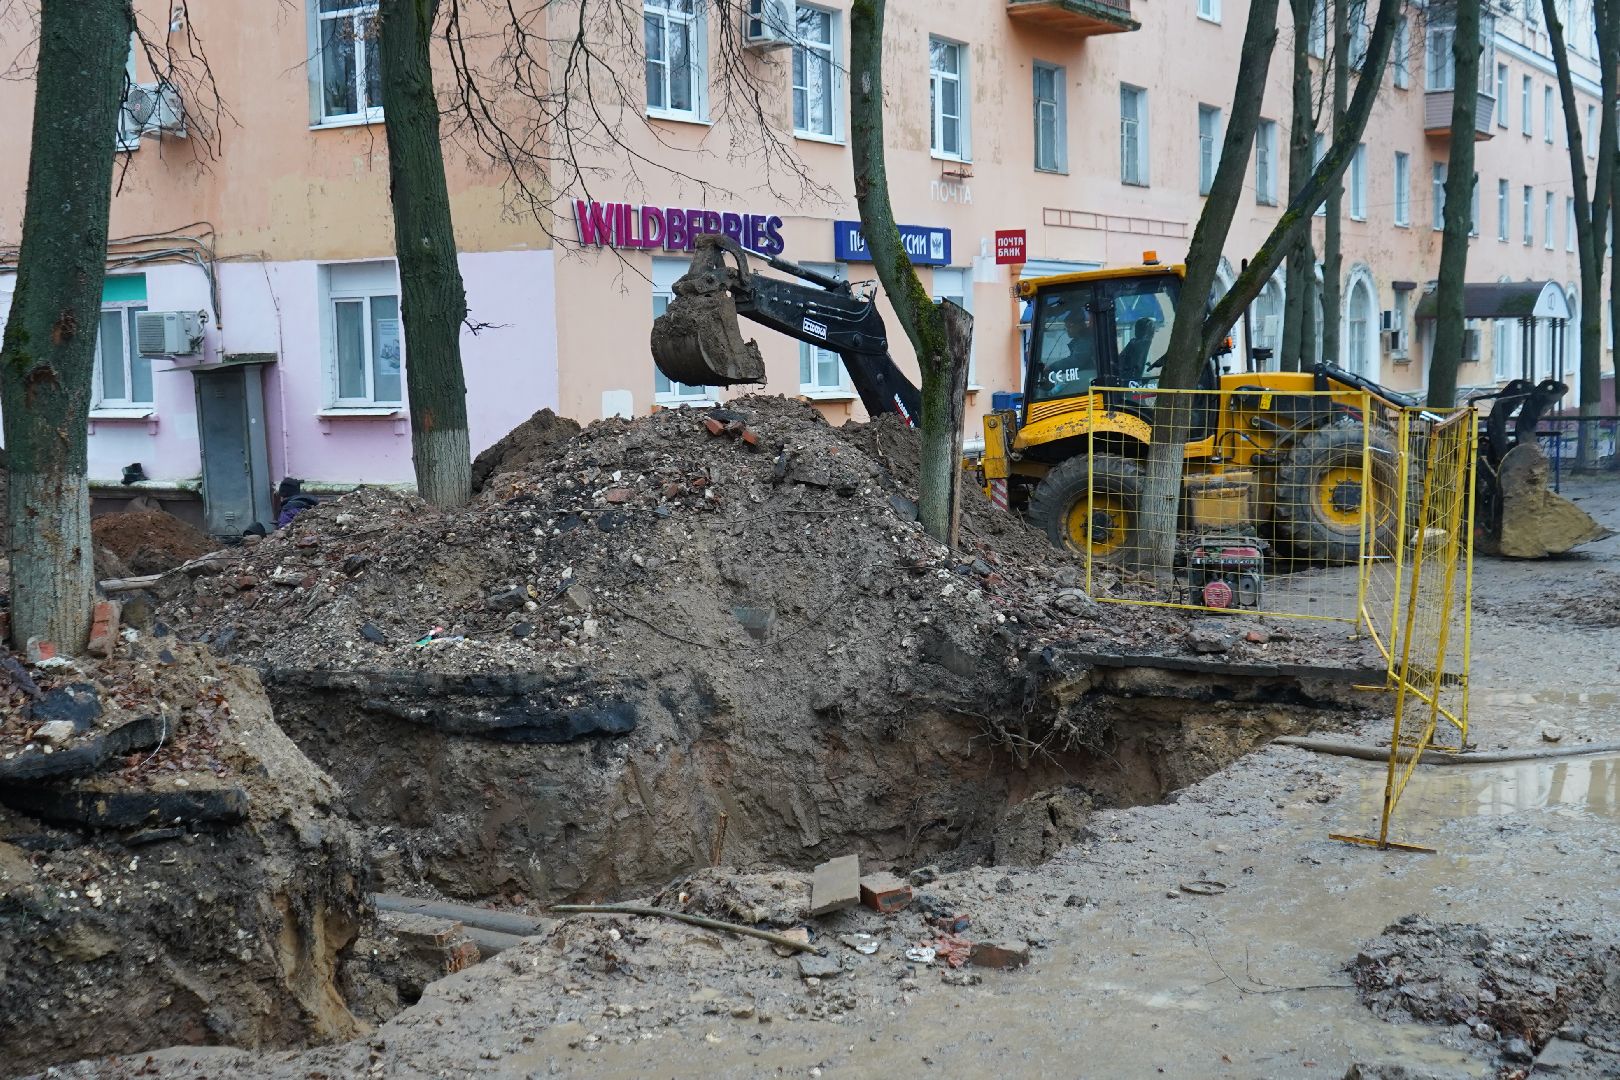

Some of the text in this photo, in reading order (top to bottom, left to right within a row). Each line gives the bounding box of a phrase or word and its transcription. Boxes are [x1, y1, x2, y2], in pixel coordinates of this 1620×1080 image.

[930, 180, 973, 205] ПОЧТА
[573, 199, 785, 256] WILDBERRIES
[998, 237, 1024, 247] ПОЧТА
[998, 247, 1021, 257] БАНК
